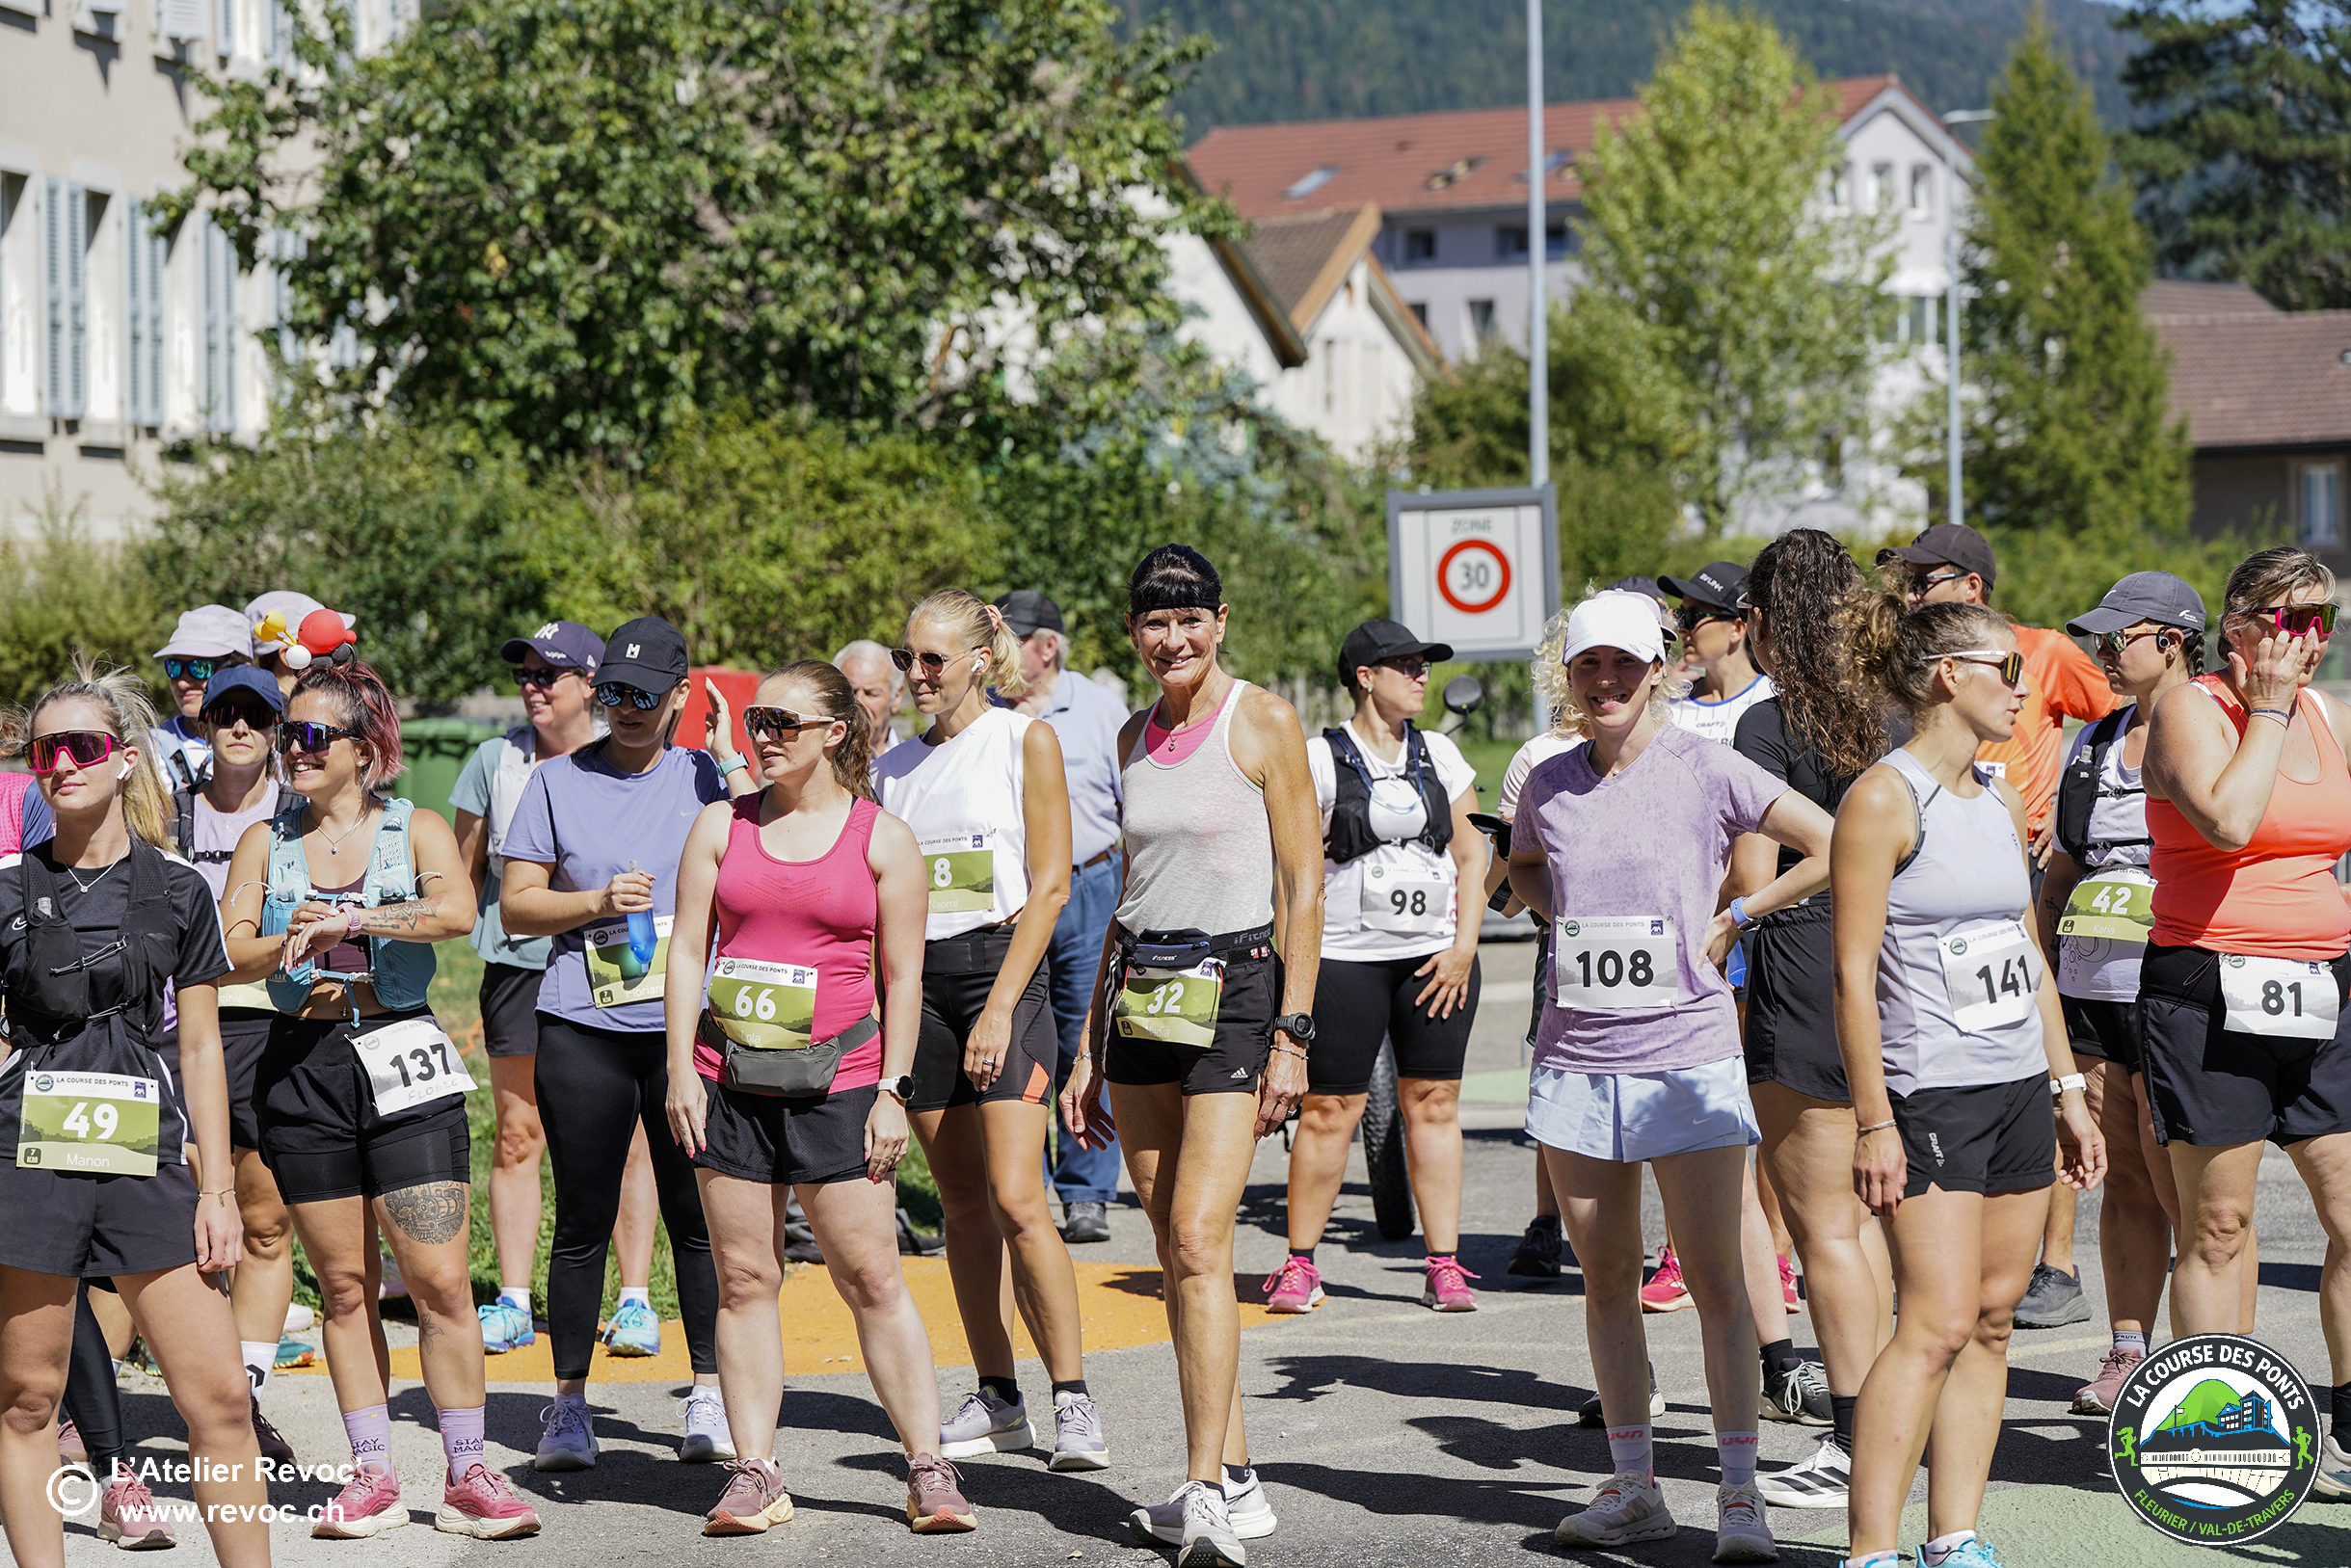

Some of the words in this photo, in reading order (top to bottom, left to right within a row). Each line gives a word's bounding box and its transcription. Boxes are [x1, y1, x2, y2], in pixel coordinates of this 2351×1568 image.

[1452, 518, 1492, 533] ZONE
[1459, 562, 1490, 591] 30
[933, 857, 952, 888] 8
[928, 897, 958, 910] Naomi
[1391, 890, 1427, 917] 98
[2092, 886, 2131, 915] 42
[1978, 931, 1998, 941] COURSE
[2093, 923, 2115, 935] Katia
[1575, 949, 1654, 988] 108
[1975, 954, 2032, 1004] 141
[735, 985, 777, 1021] 66
[1147, 981, 1184, 1015] 32
[2261, 979, 2303, 1018] 81
[740, 1030, 761, 1044] Lola
[1145, 1025, 1170, 1038] Nadia
[389, 1043, 452, 1088] 137
[63, 1102, 119, 1140] 49
[26, 1156, 39, 1164] KM
[66, 1153, 110, 1168] Manon
